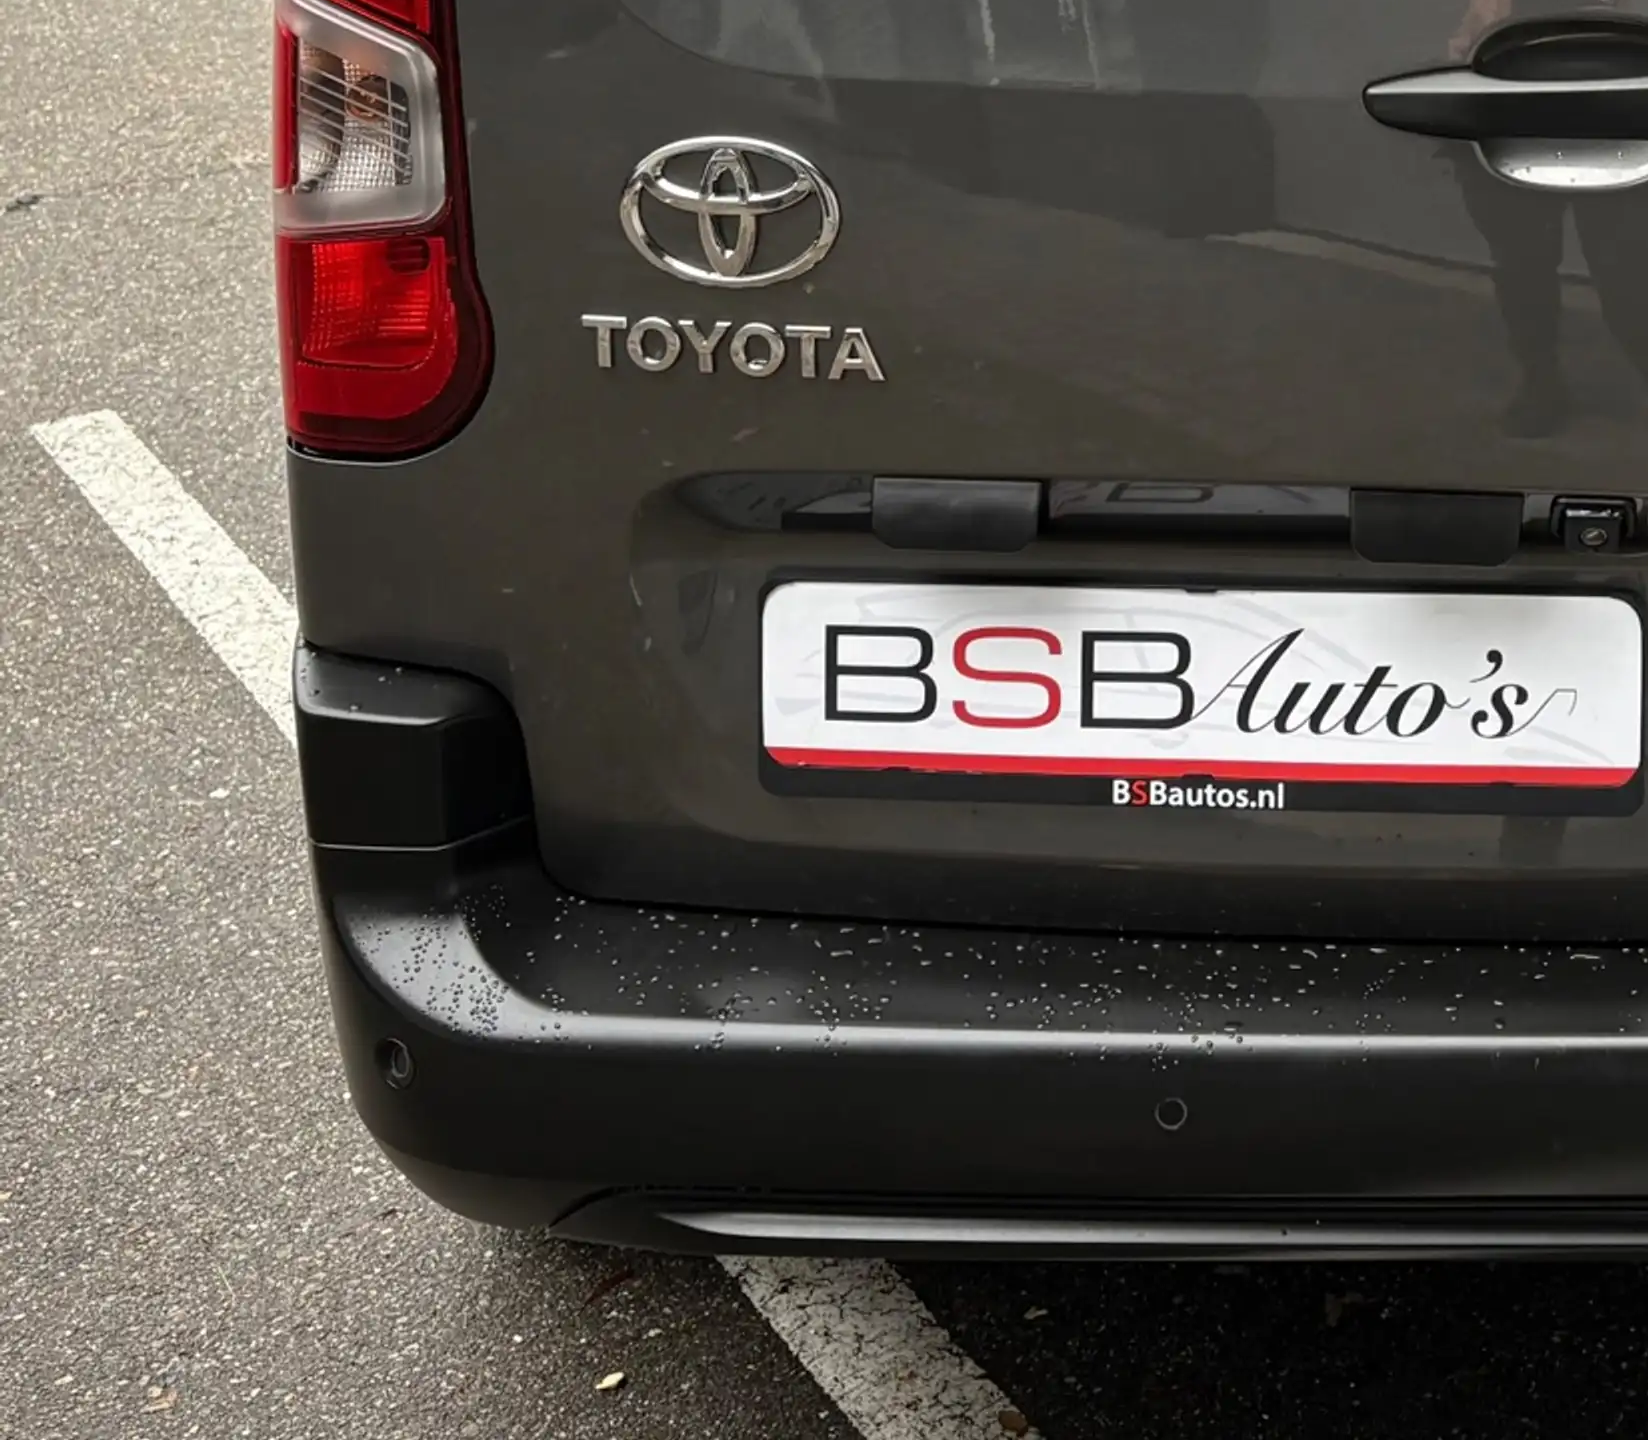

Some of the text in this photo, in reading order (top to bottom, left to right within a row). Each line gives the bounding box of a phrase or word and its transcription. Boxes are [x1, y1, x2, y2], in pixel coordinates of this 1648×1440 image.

[581, 314, 885, 381] TOYOTA
[824, 624, 1577, 739] BSB Auto's
[1112, 779, 1285, 809] BSBautos.nl
